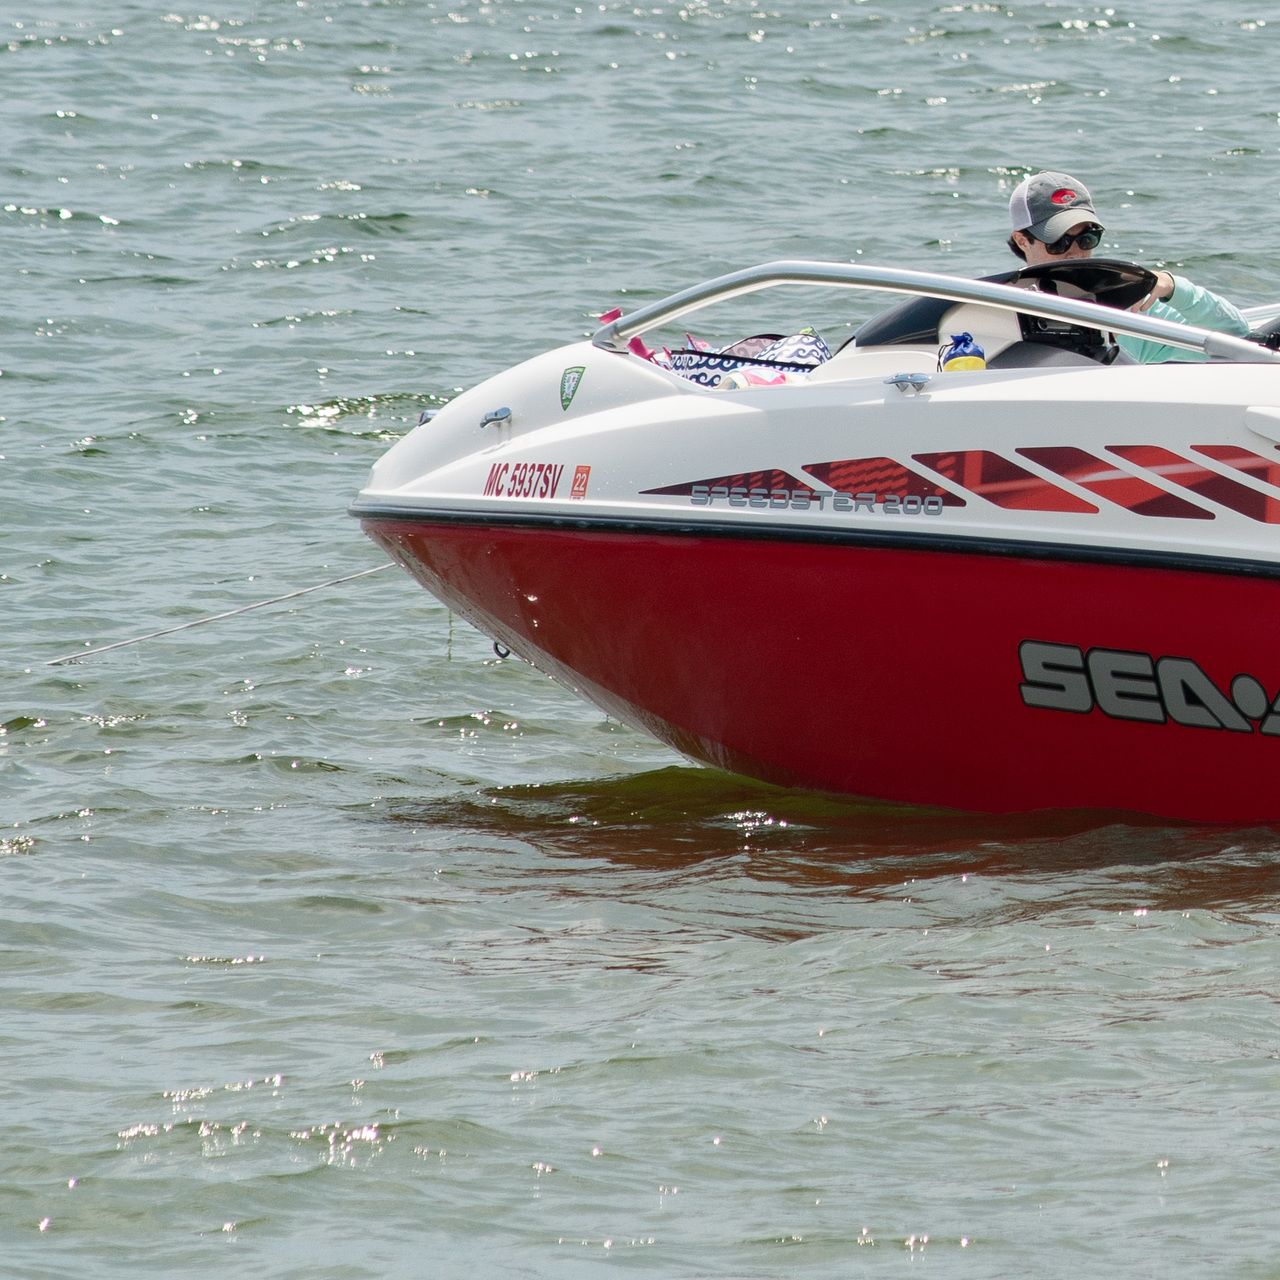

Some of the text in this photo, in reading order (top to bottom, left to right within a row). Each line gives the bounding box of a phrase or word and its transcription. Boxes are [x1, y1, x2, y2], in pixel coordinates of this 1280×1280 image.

[483, 463, 564, 499] MC 5937SV
[573, 472, 587, 491] 22
[690, 485, 943, 516] SPEEDSTER 200
